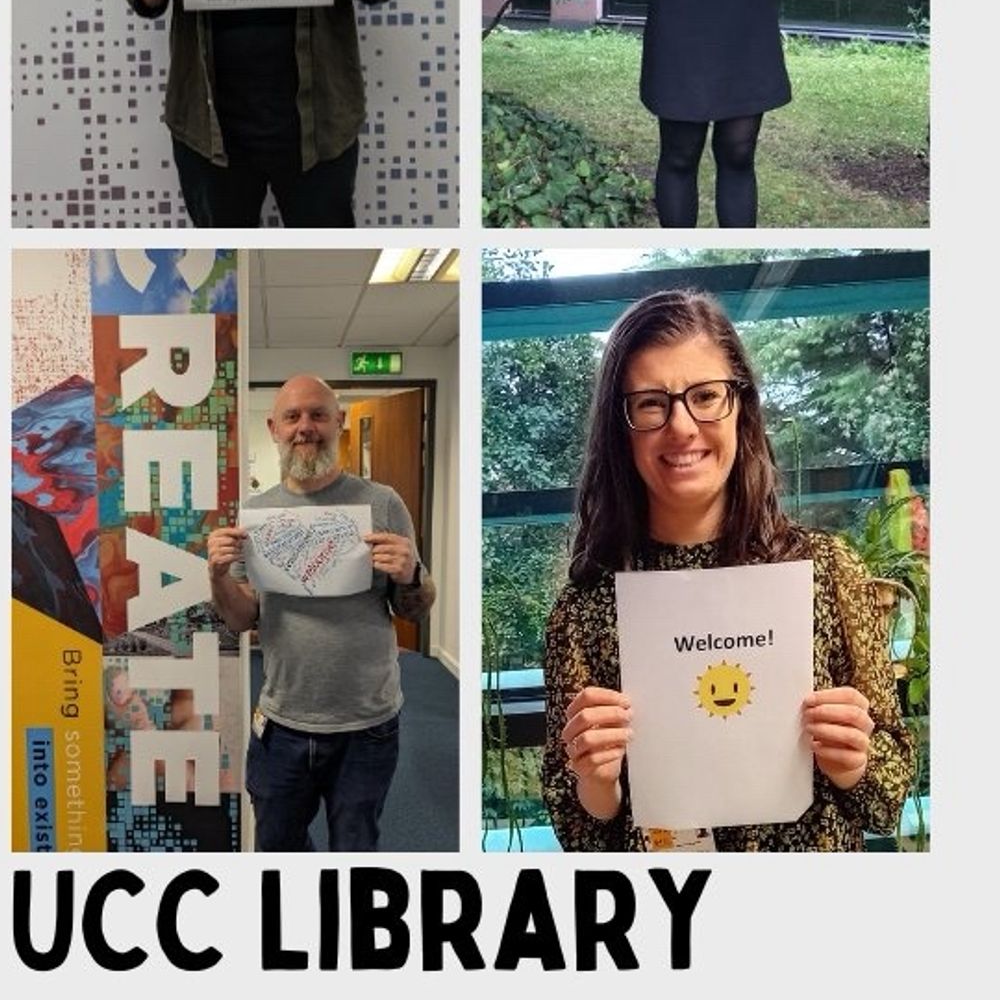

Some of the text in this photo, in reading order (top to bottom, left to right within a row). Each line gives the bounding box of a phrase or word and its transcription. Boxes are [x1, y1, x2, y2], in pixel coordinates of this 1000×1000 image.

[673, 629, 774, 654] Welcome!
[61, 649, 82, 719] Bring
[32, 740, 51, 787] into
